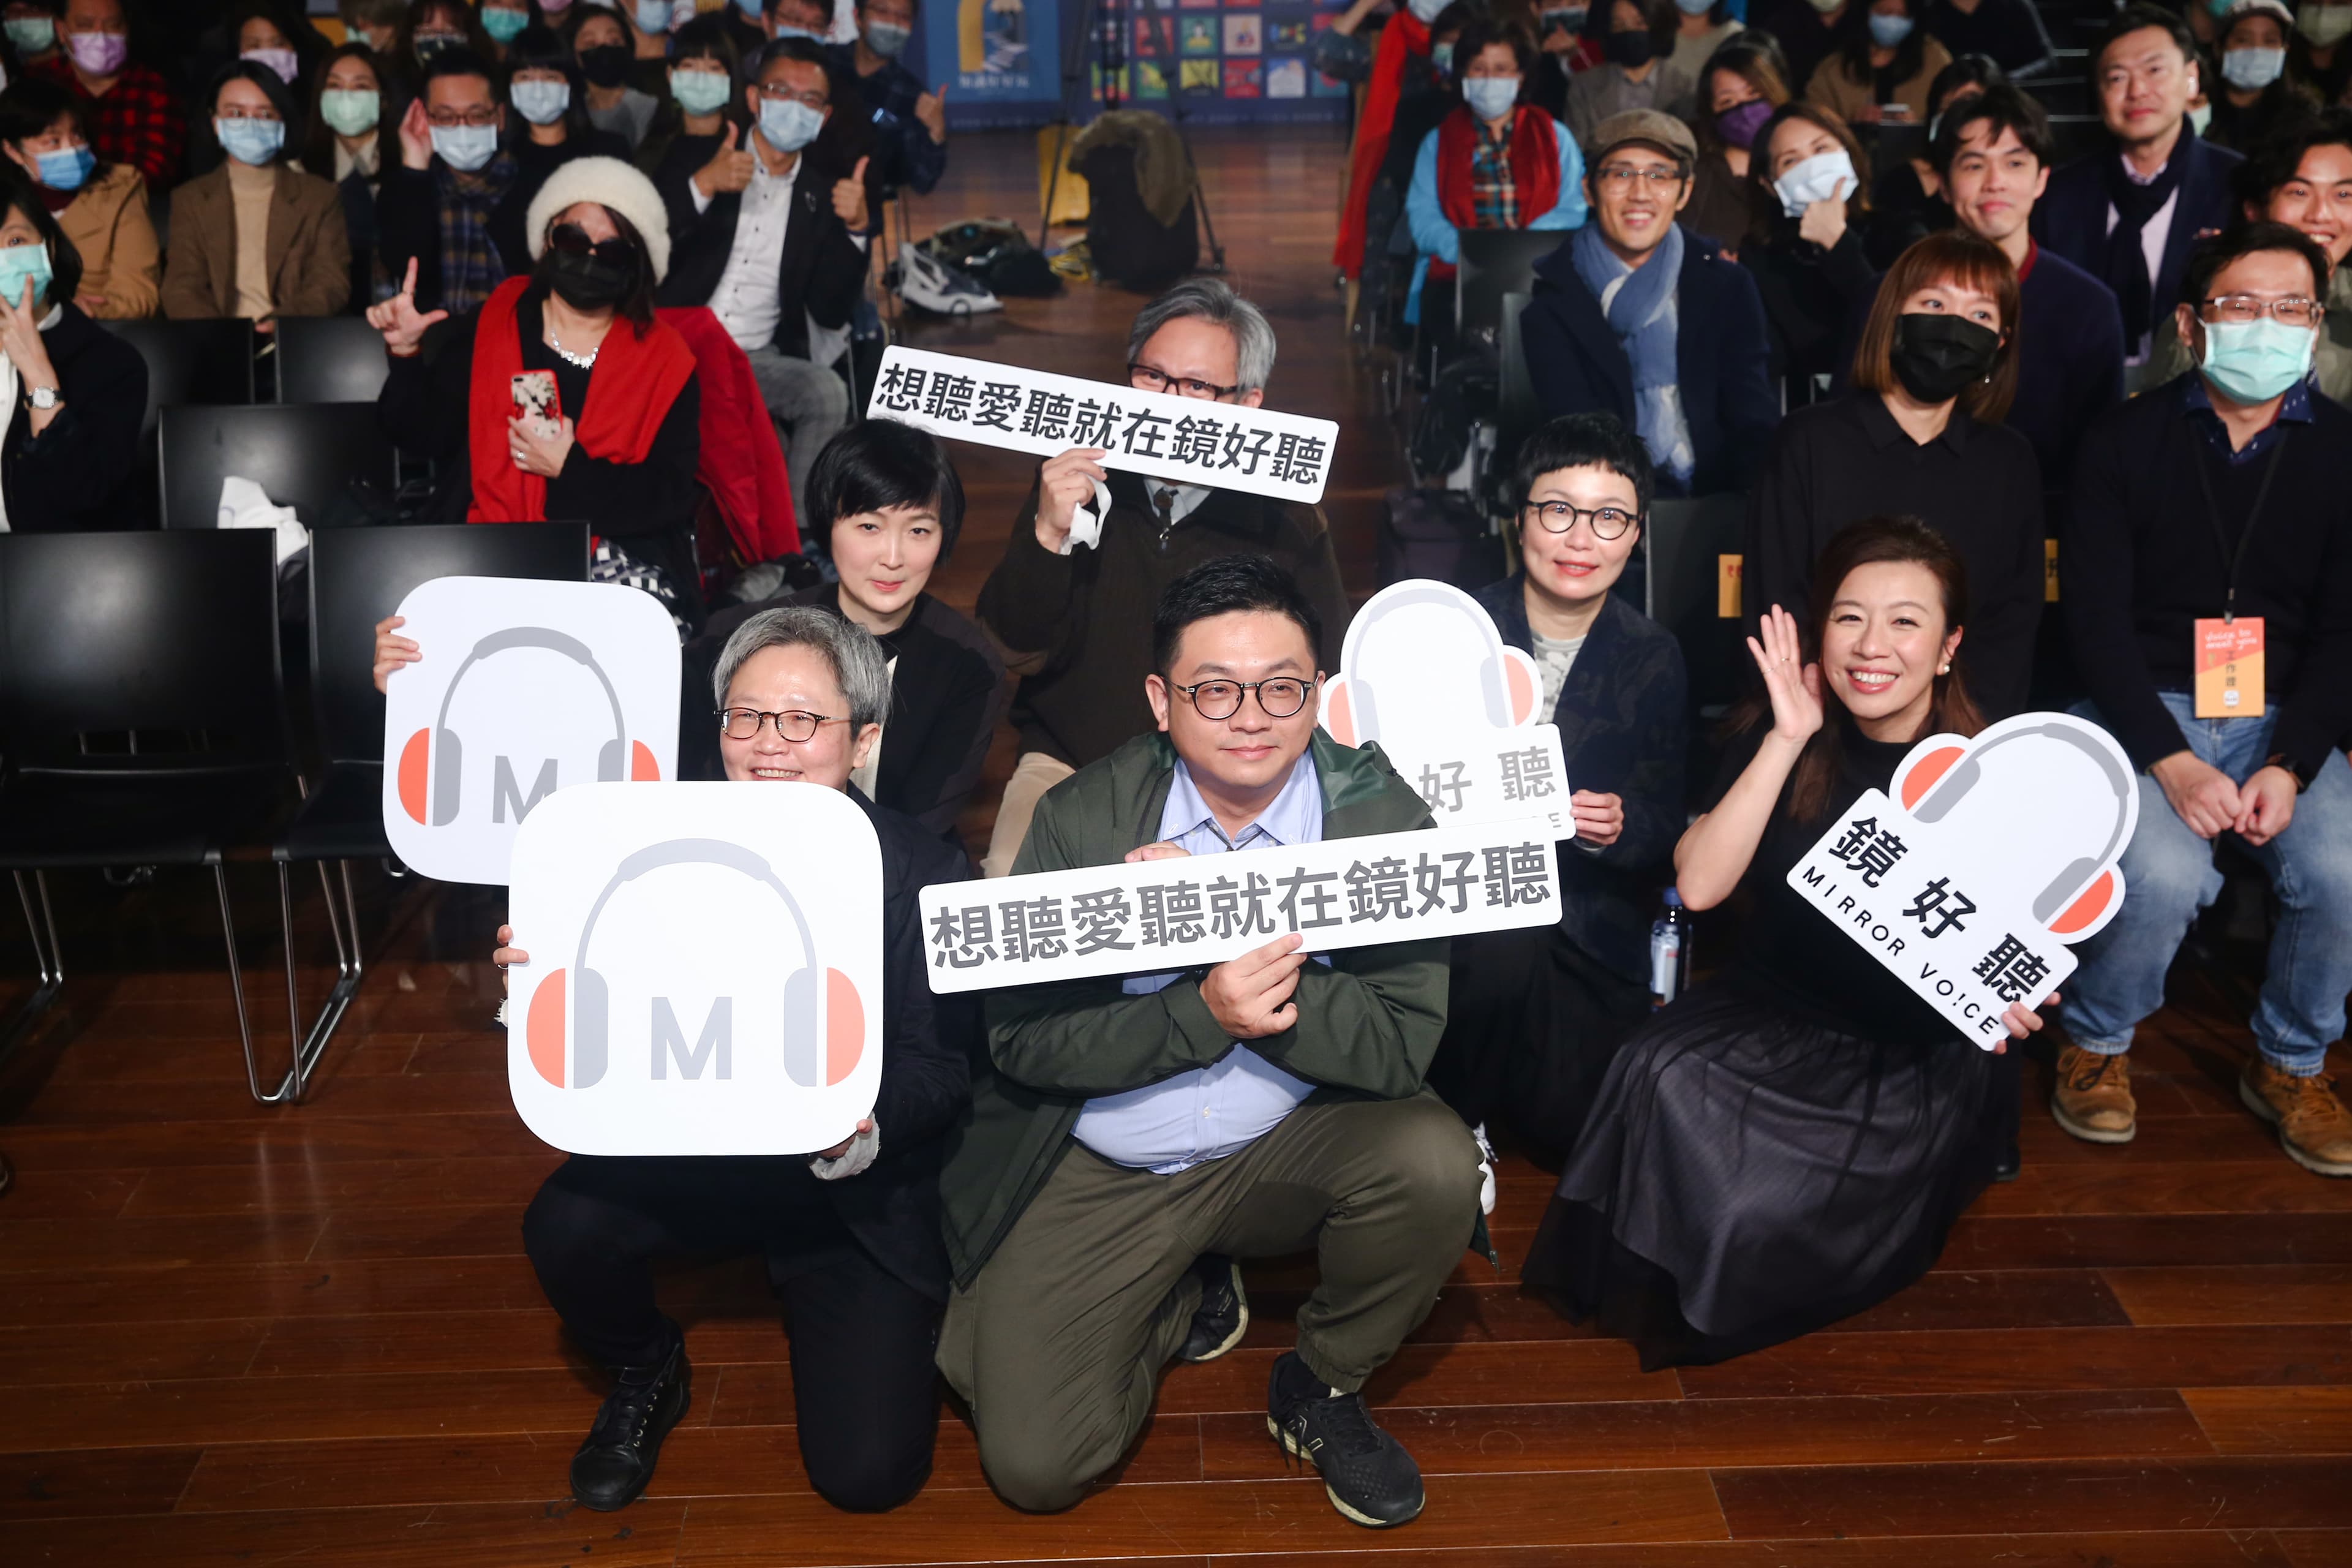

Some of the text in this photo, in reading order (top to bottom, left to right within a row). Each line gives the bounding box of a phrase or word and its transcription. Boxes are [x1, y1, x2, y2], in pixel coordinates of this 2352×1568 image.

[876, 363, 1326, 484] 想聽愛聽就在鏡好聽
[492, 755, 558, 824] M
[930, 840, 1551, 968] 想聽愛聽就在鏡好聽
[1803, 865, 1905, 956] MIRROR
[1828, 817, 2051, 1003] 鏡好聽
[651, 997, 732, 1080] M
